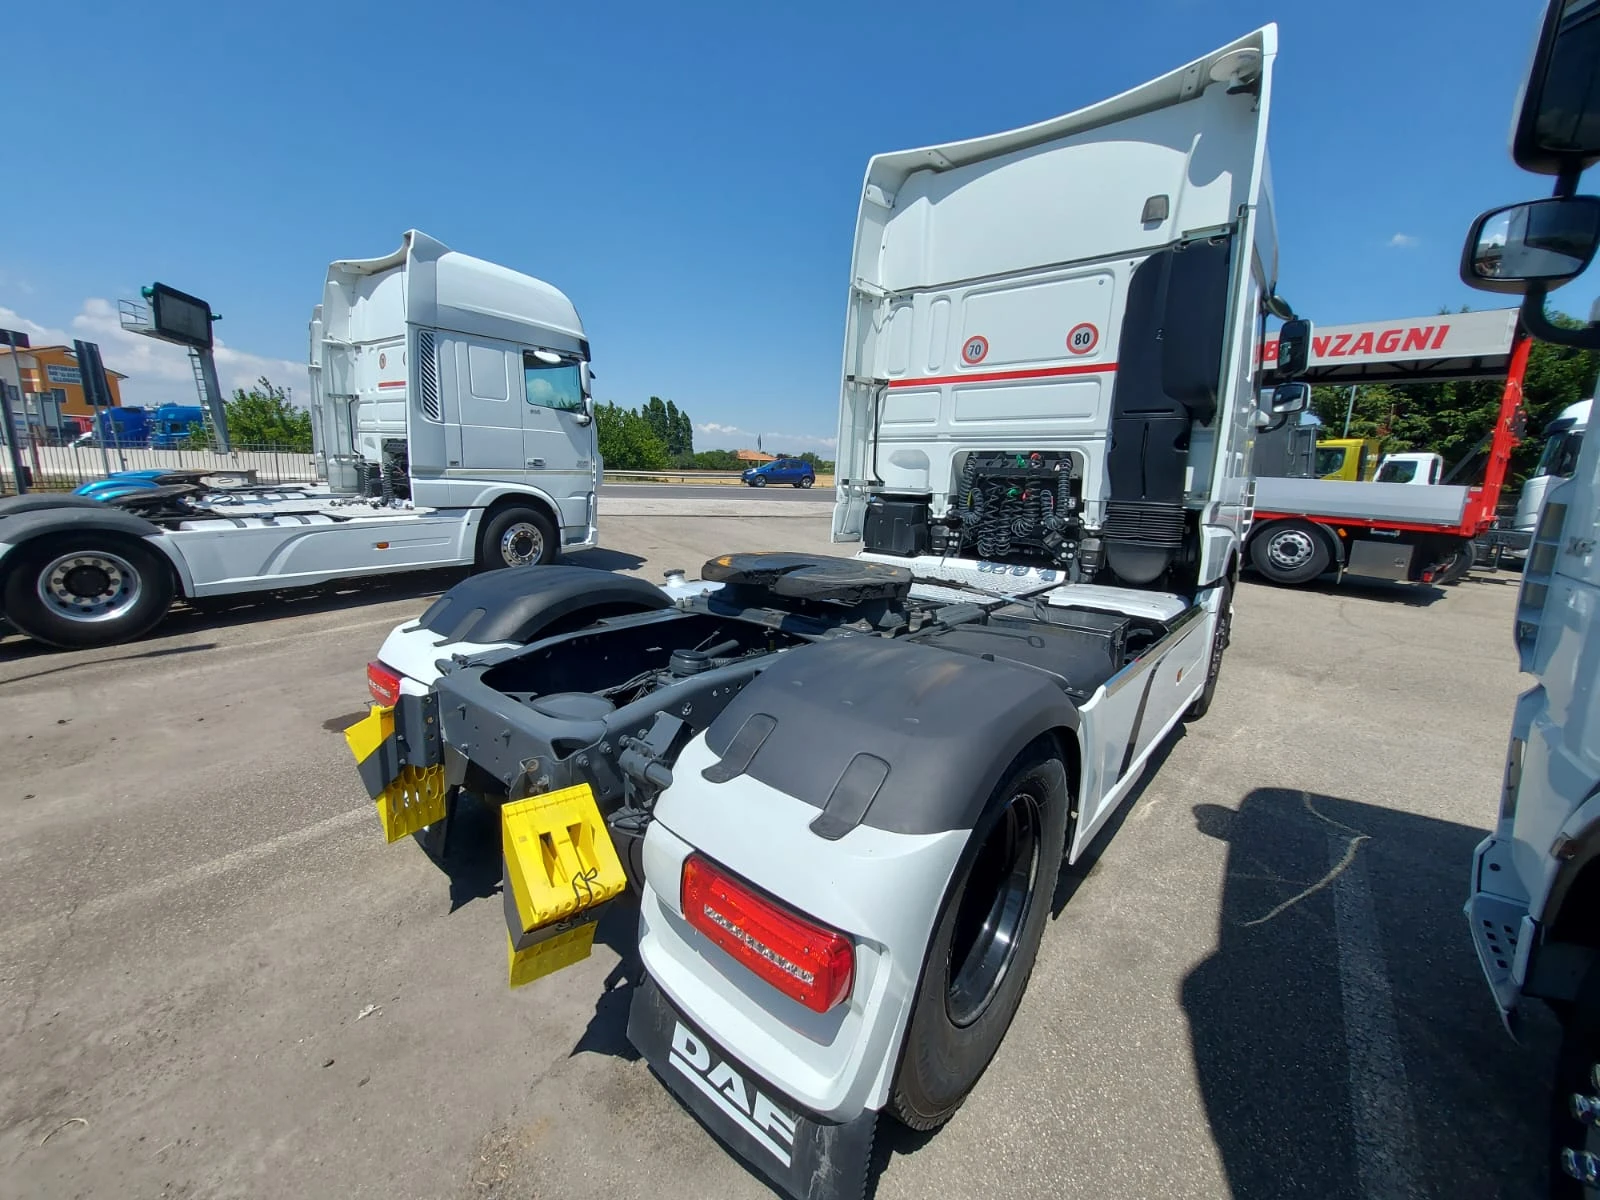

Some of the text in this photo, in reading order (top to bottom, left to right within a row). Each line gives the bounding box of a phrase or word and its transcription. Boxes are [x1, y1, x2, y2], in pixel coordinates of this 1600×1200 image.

[969, 344, 982, 357] 70
[1074, 332, 1090, 346] 80
[1262, 325, 1450, 362] BNZAGNI
[671, 1020, 797, 1147] DAF
